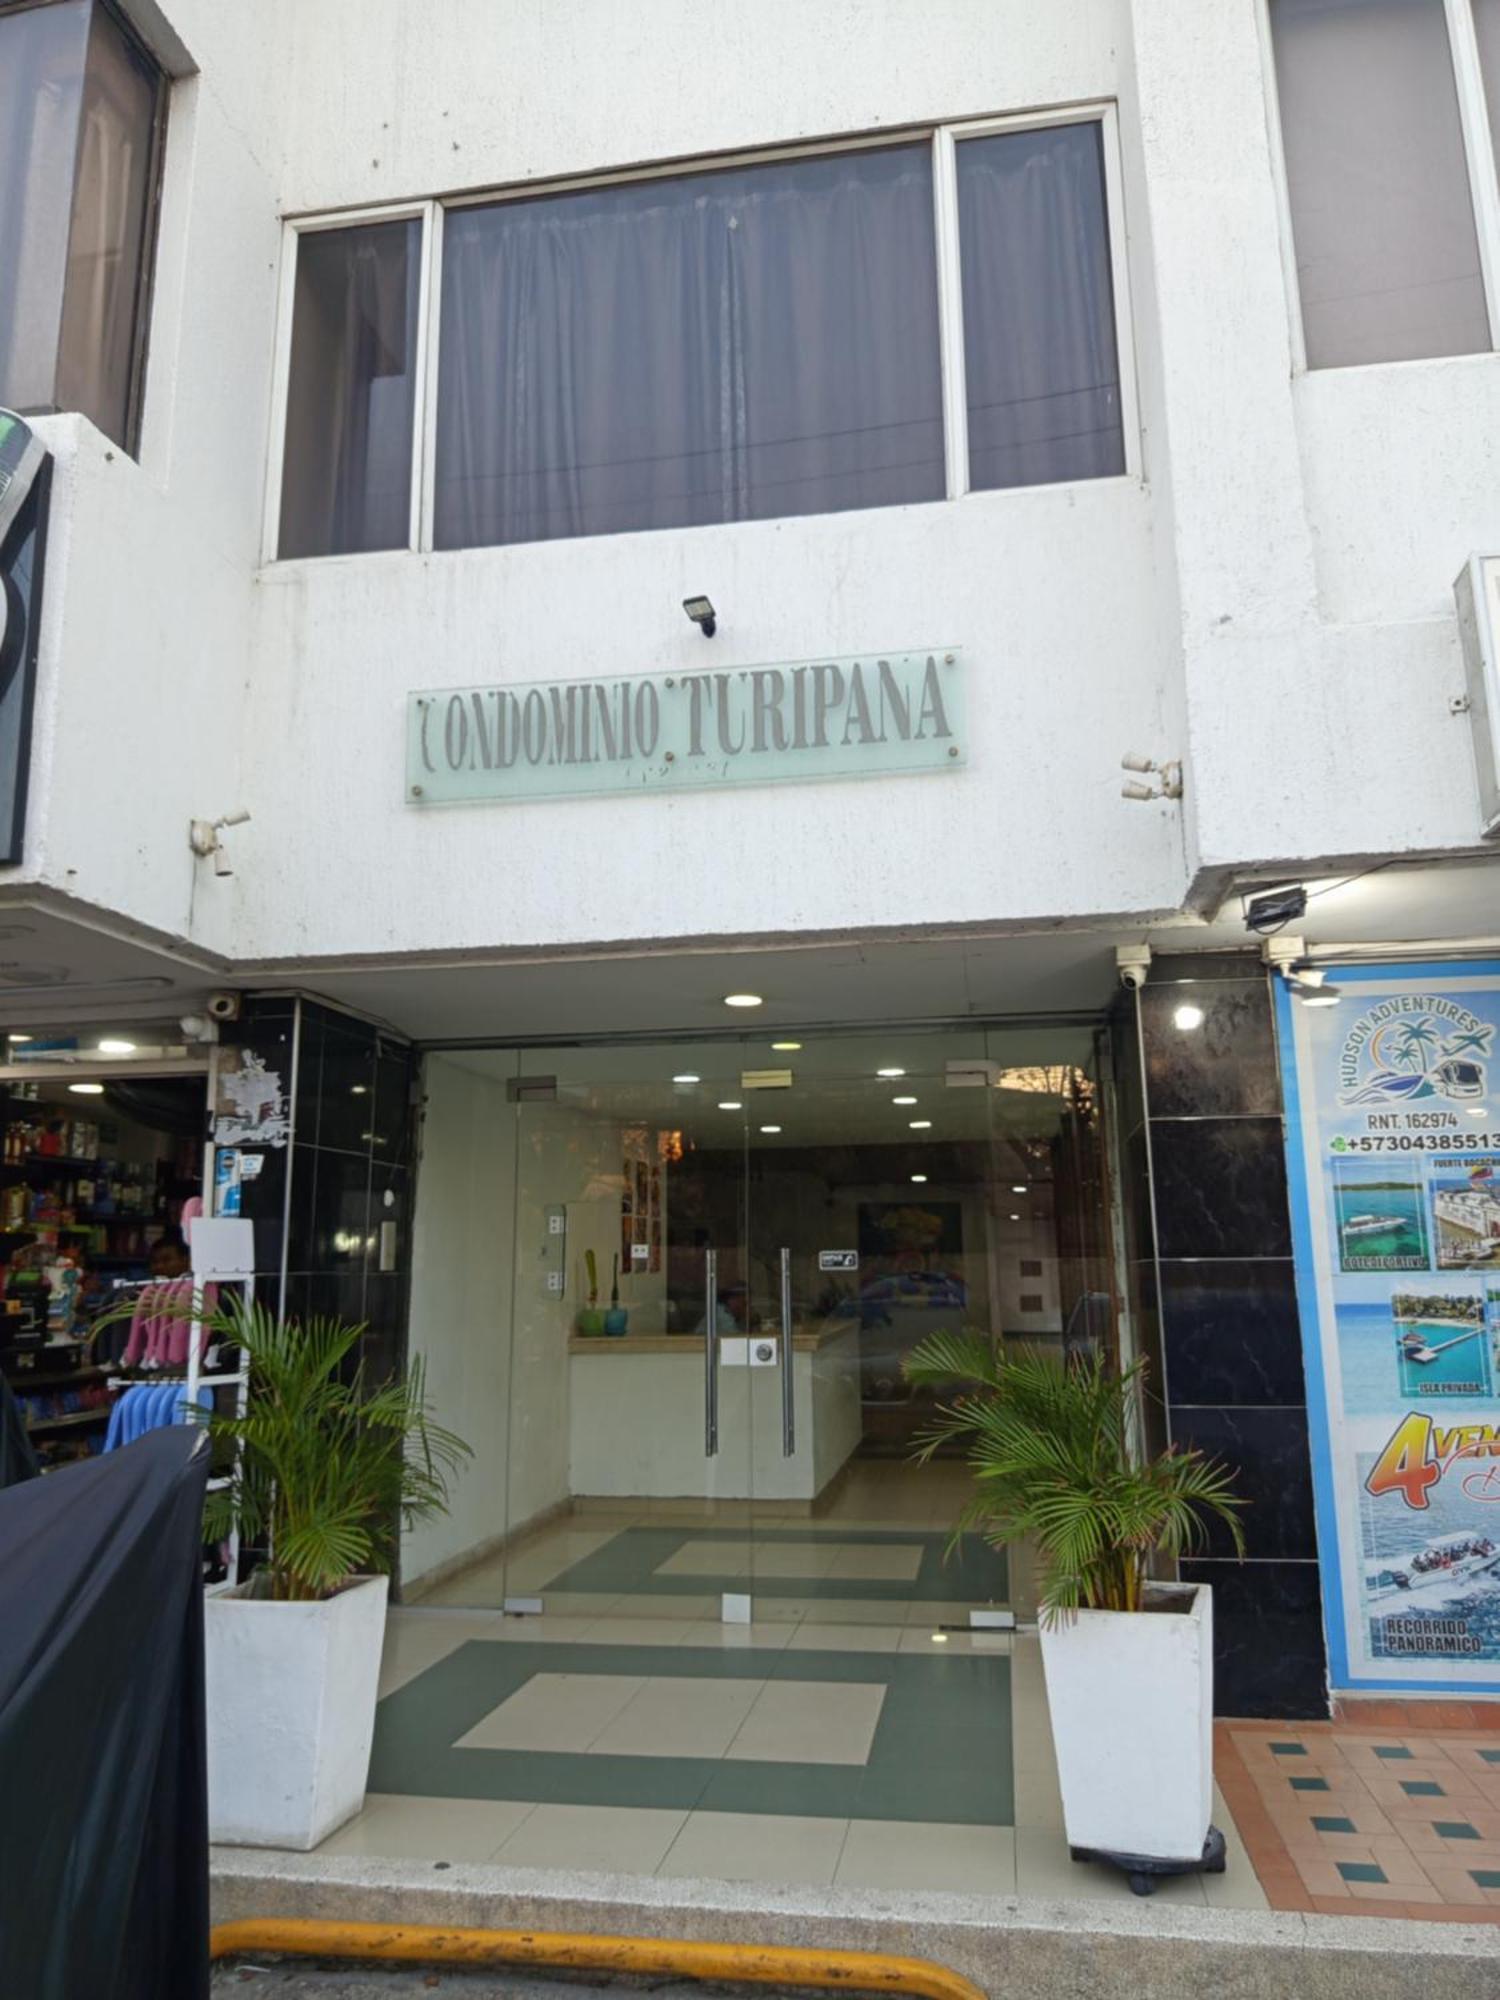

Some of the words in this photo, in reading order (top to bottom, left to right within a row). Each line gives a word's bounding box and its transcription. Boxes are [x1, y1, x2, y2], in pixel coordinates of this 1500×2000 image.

[680, 655, 953, 757] TURIPANA
[1341, 1021, 1372, 1088] HUDSON
[1369, 996, 1480, 1033] ADVENTURES
[1367, 1114, 1401, 1130] RNT.
[1405, 1113, 1458, 1129] 162974
[1419, 1383, 1441, 1393] ISLA
[1387, 1619, 1467, 1636] RECORRIDO
[1388, 1635, 1481, 1653] PANORAMICO
